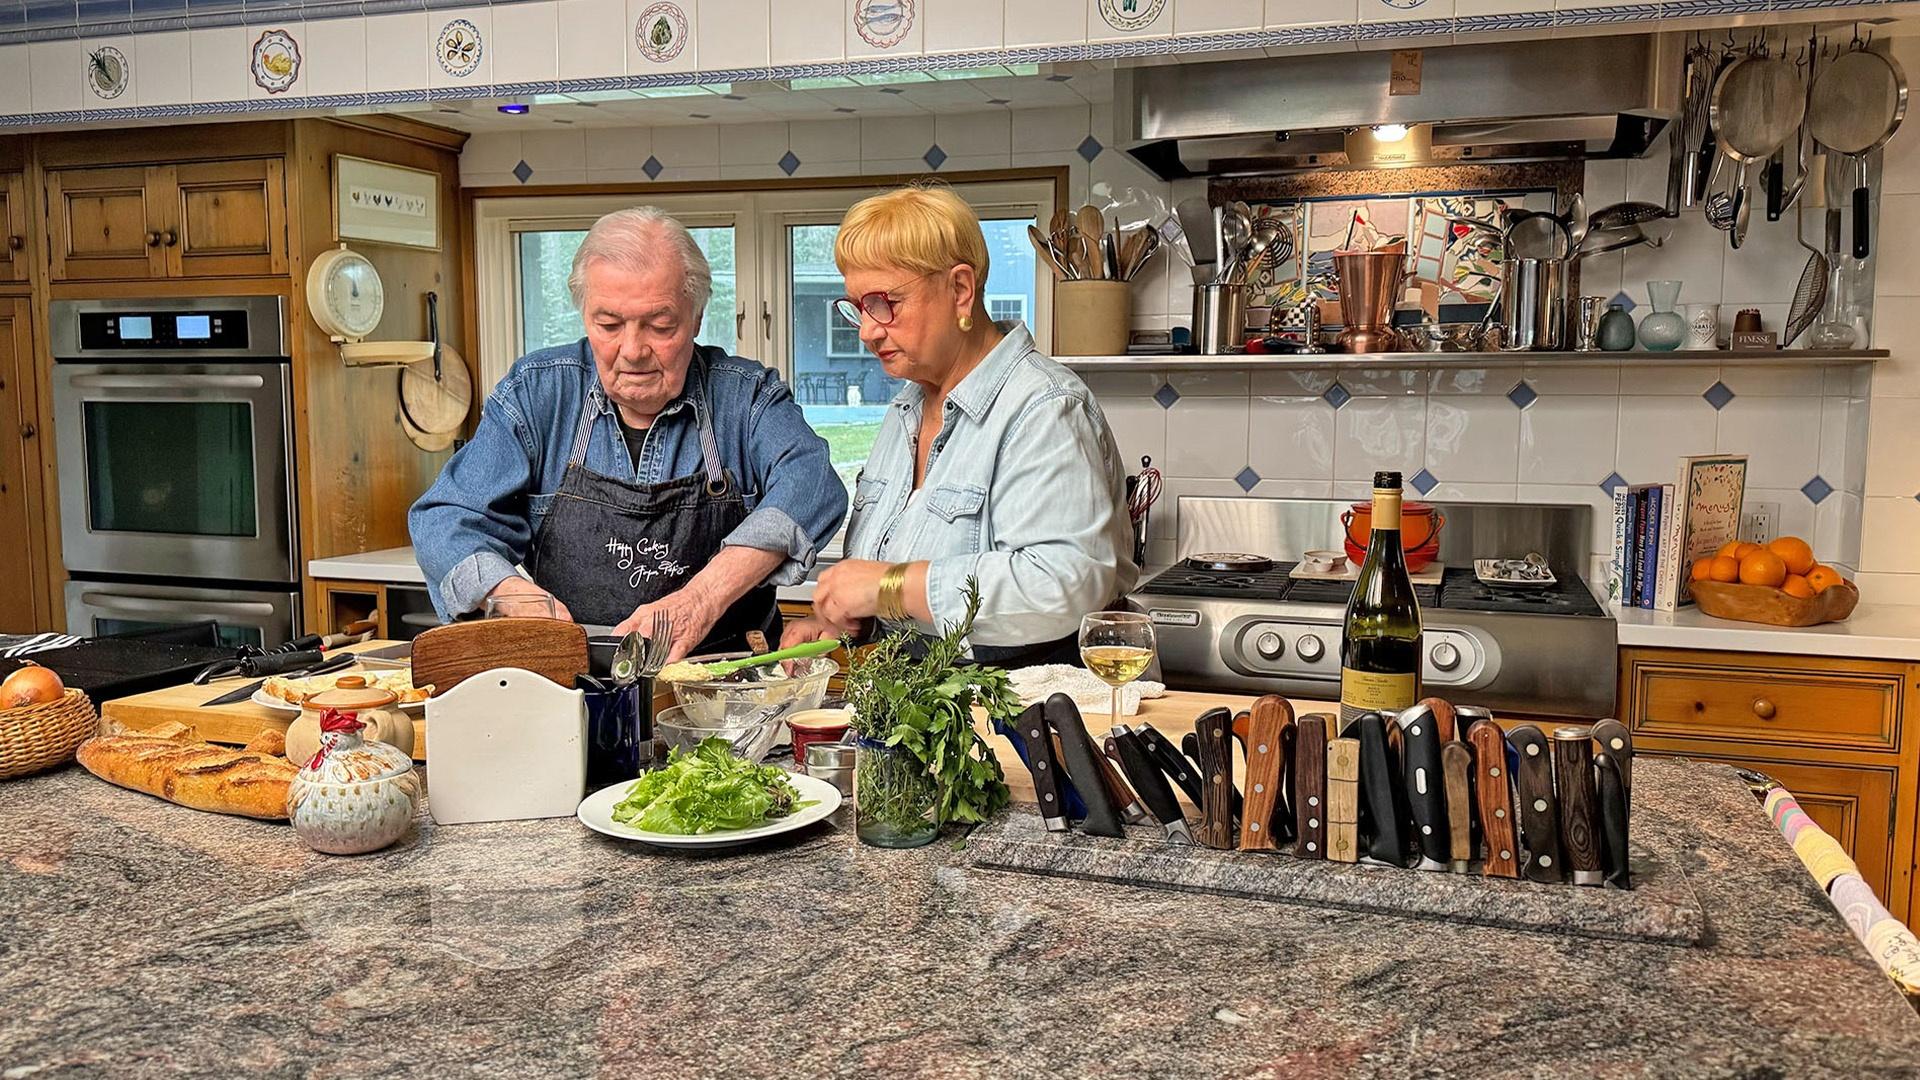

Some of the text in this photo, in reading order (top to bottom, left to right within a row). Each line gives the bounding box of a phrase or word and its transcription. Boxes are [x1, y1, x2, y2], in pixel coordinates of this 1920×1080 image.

[1738, 335, 1770, 345] FINESSE
[1663, 493, 1671, 514] Jacques
[1696, 503, 1730, 514] menus
[1648, 496, 1656, 526] JACQUES
[1615, 516, 1624, 539] Quick
[605, 537, 669, 569] Happy Cooking
[1611, 545, 1623, 571] Simple
[1638, 547, 1646, 558] Fast
[1637, 558, 1645, 572] Food
[1637, 571, 1644, 580] My
[1635, 579, 1644, 592] Way
